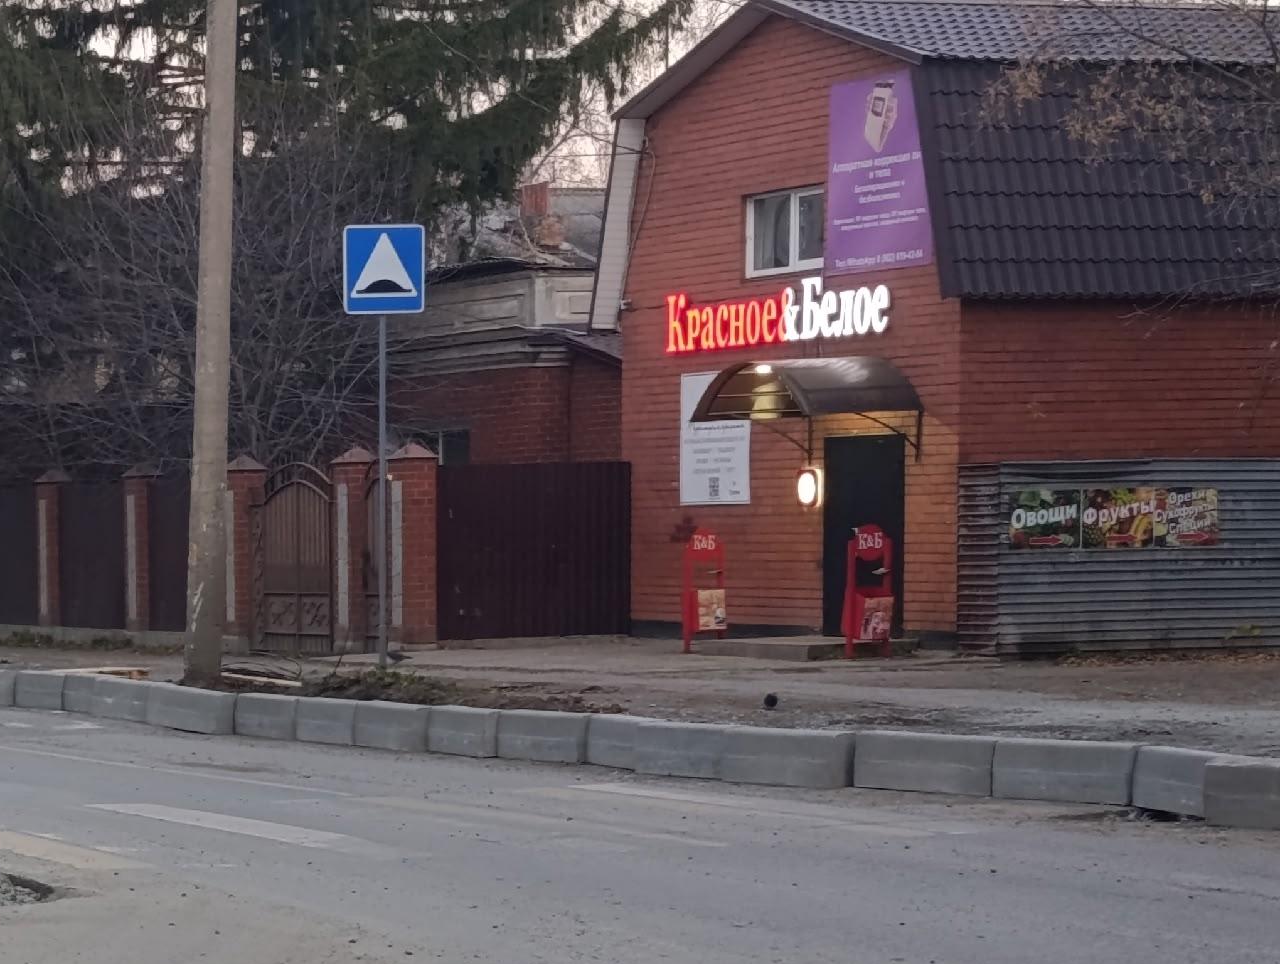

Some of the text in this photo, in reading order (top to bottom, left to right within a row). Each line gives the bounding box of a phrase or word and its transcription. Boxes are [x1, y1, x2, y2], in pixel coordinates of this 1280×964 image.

[666, 276, 889, 352] Красное&Белое
[1168, 490, 1208, 505] Орехи
[1012, 504, 1078, 529] Овощи
[1083, 499, 1154, 527] Фрукты
[693, 534, 716, 550] К&Б
[858, 532, 883, 550] К&Б
